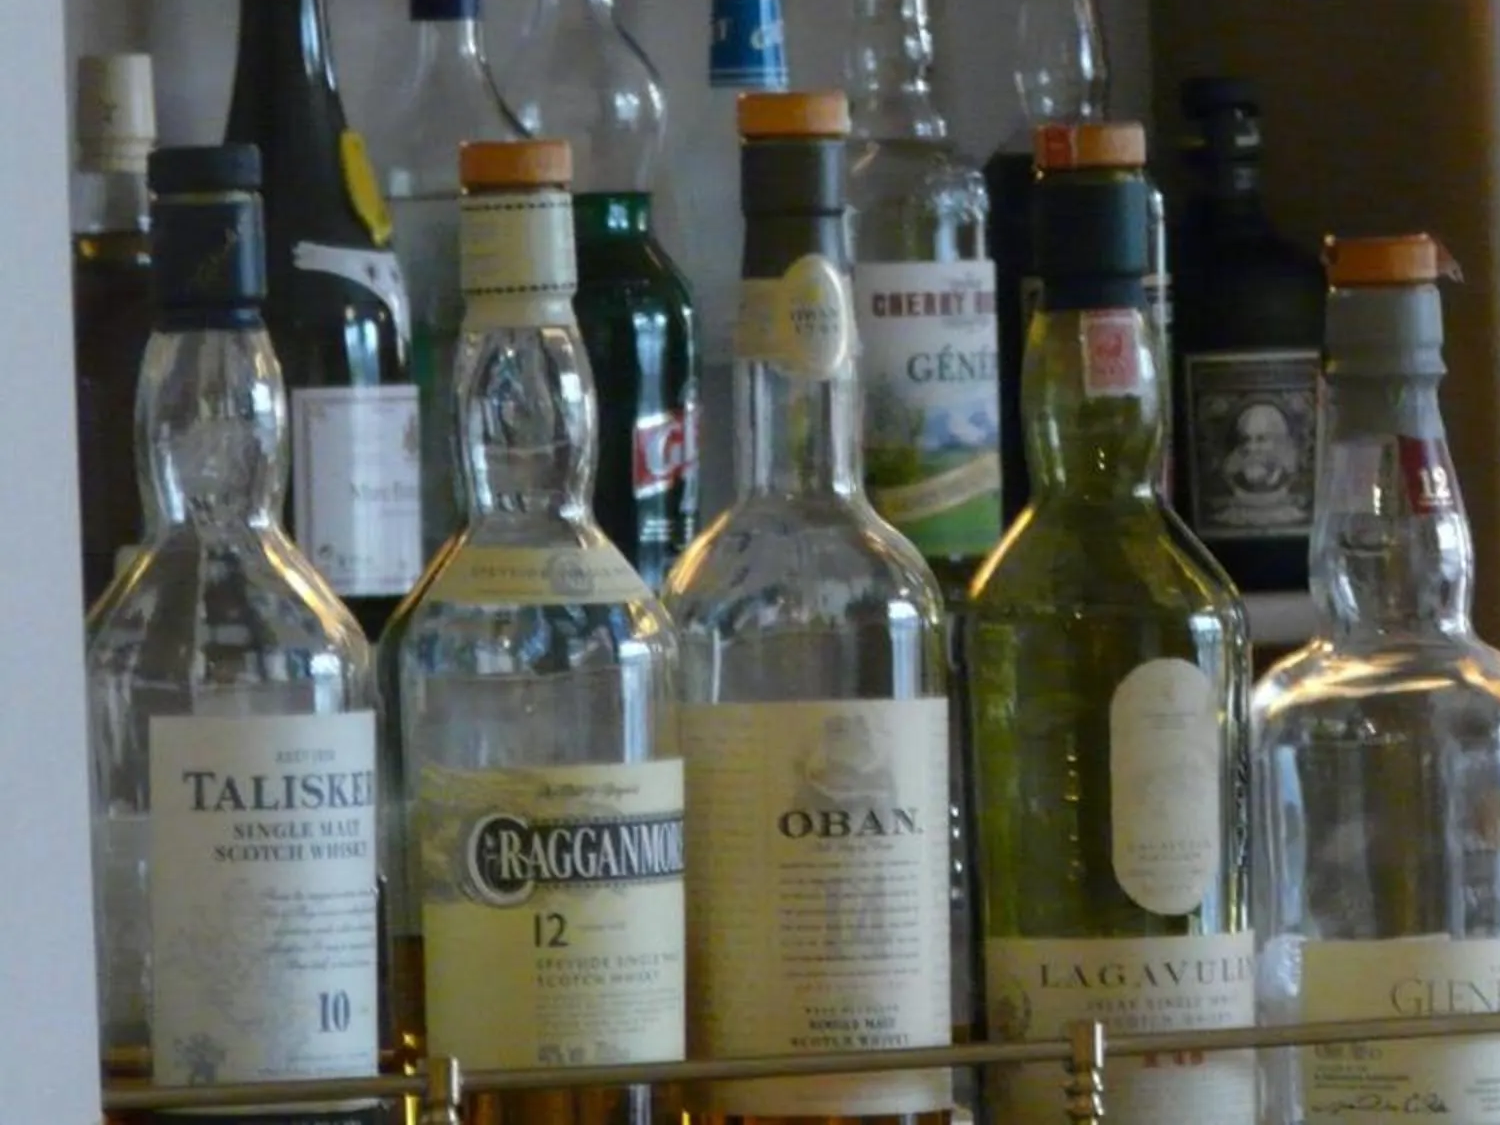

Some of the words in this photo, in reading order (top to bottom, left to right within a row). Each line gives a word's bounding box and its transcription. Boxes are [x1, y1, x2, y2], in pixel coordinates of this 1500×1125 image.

[872, 291, 965, 318] CHERRY
[533, 912, 570, 949] 12
[316, 989, 351, 1034] 10
